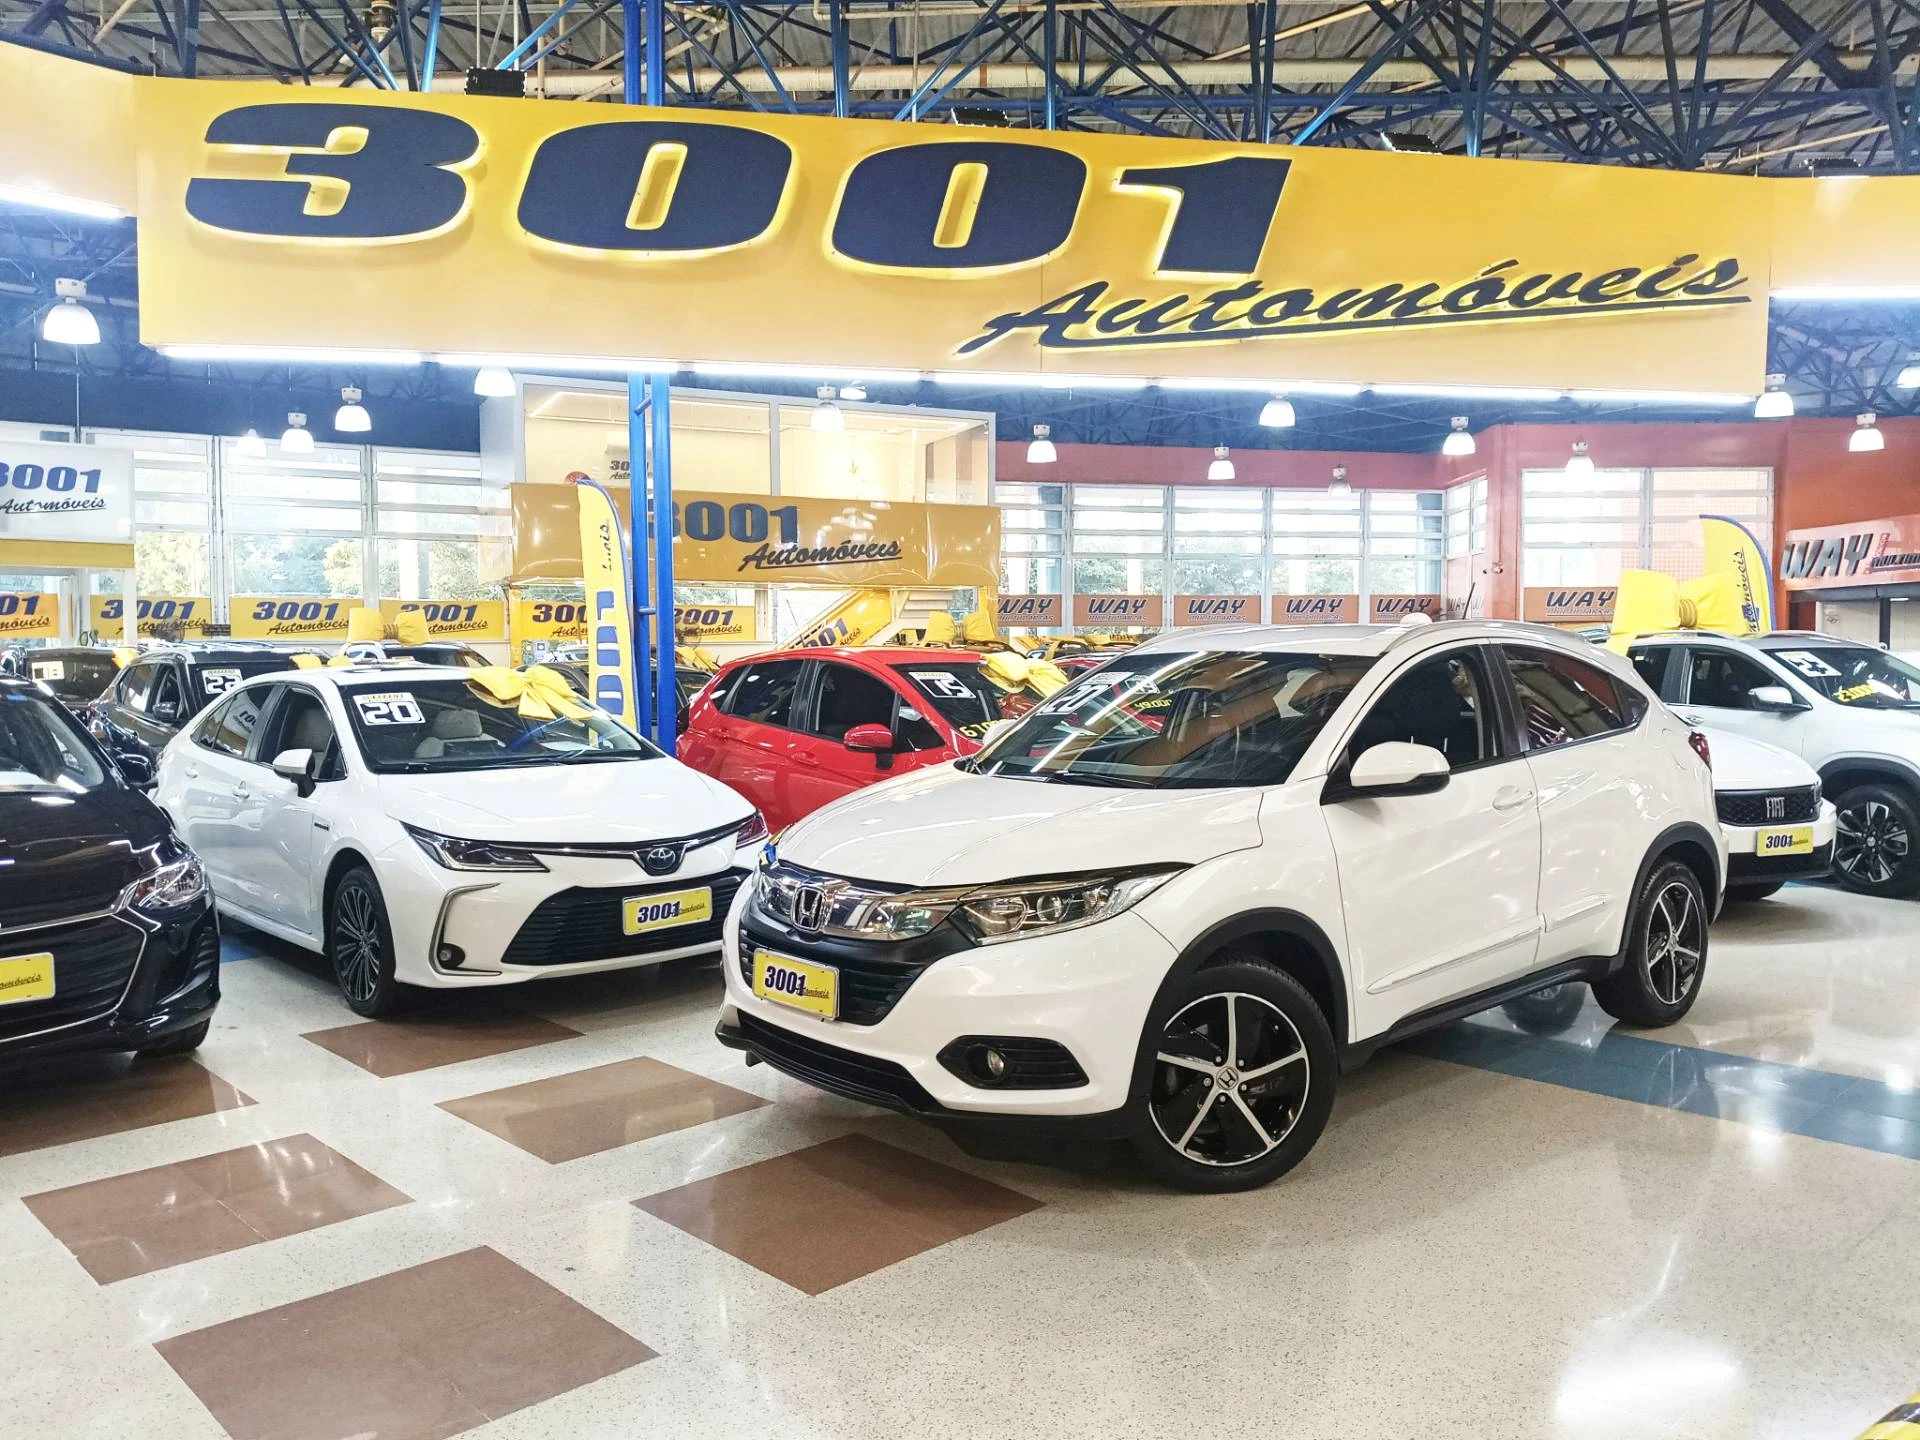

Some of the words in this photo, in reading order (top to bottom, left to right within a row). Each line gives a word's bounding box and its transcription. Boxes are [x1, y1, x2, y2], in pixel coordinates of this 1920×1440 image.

[185, 102, 1292, 275] 3001
[956, 253, 1749, 355] Automóveis
[648, 500, 797, 544] 001
[738, 540, 902, 571] Automóveis
[1781, 533, 1873, 580] WAY
[1088, 599, 1147, 614] WAY
[1188, 599, 1246, 614] WAY
[1286, 598, 1343, 613] WAY
[1376, 598, 1432, 613] WAY
[1546, 590, 1615, 607] WAY
[253, 602, 339, 621] 3001
[596, 591, 623, 716] 001
[361, 701, 422, 723] 20
[1766, 797, 1784, 818] FIAT
[1766, 835, 1793, 848] 3001
[637, 901, 681, 924] 3001
[764, 965, 807, 996] 3001
